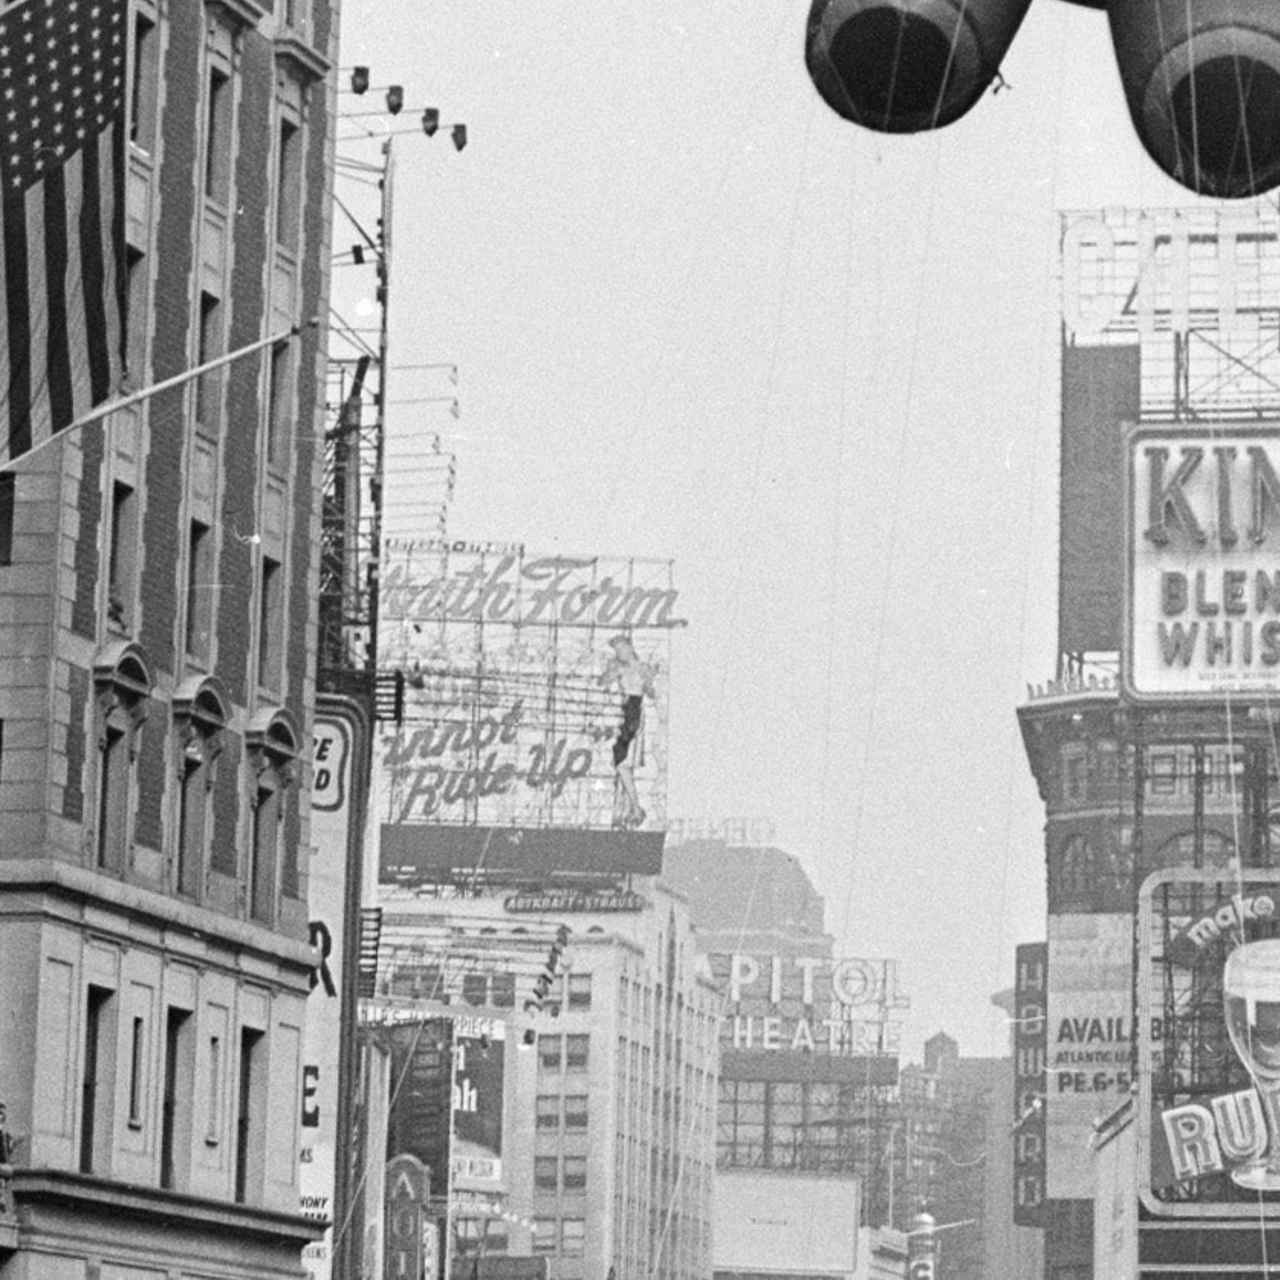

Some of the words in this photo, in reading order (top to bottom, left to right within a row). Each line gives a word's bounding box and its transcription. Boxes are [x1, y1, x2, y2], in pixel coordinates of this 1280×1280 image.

[520, 557, 678, 622] Form
[1187, 894, 1274, 947] make
[697, 953, 910, 1008] PITOL
[733, 1018, 899, 1055] HEATRE
